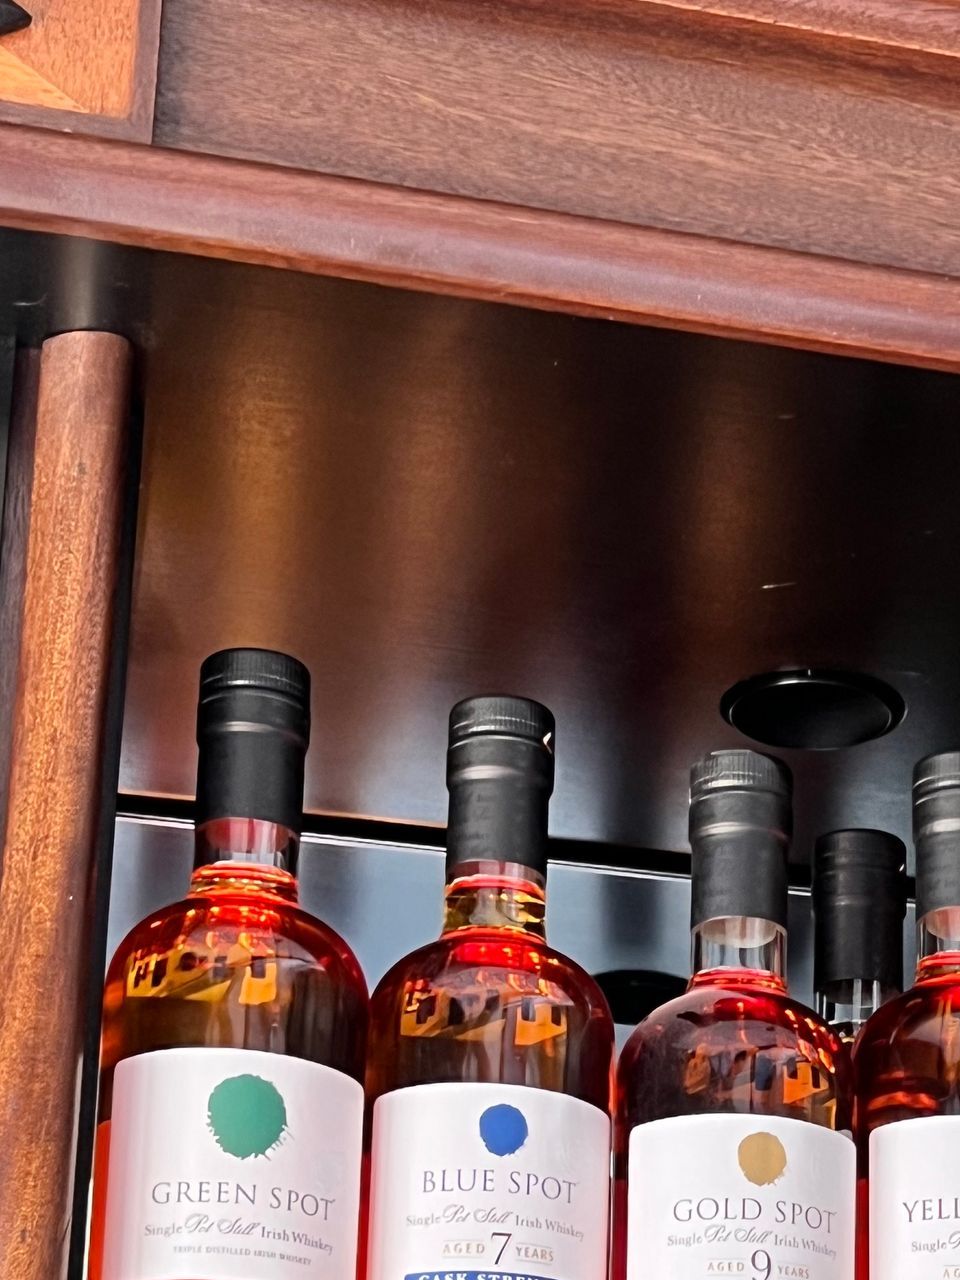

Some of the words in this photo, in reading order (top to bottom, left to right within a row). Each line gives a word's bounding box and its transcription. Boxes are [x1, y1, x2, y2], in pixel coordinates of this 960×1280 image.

[152, 1182, 256, 1204] GREEN
[270, 1187, 335, 1220] SPOT
[423, 1169, 494, 1193] BLUE
[508, 1171, 578, 1203] SPOT
[406, 1215, 440, 1228] Single
[442, 1204, 470, 1223] Pot
[473, 1207, 513, 1224] Still
[515, 1215, 542, 1229] Irish
[545, 1220, 584, 1241] Whiskey
[673, 1198, 762, 1221] GOLD
[775, 1201, 837, 1233] SPOT
[145, 1223, 182, 1236] Single
[185, 1213, 214, 1233] Pot
[217, 1218, 260, 1235] Still
[261, 1227, 289, 1242] Irish
[292, 1232, 333, 1255] Whiskey
[442, 1243, 485, 1254] AGED
[491, 1232, 512, 1265] 7
[516, 1246, 554, 1261] YEARS
[667, 1234, 702, 1248] Single
[704, 1225, 732, 1243] Pot
[734, 1226, 772, 1243] Still
[774, 1235, 799, 1248] Irish
[802, 1239, 837, 1260] Whiskey
[912, 1238, 947, 1253] Single
[707, 1261, 744, 1272] AGED
[778, 1264, 809, 1279] YEARS
